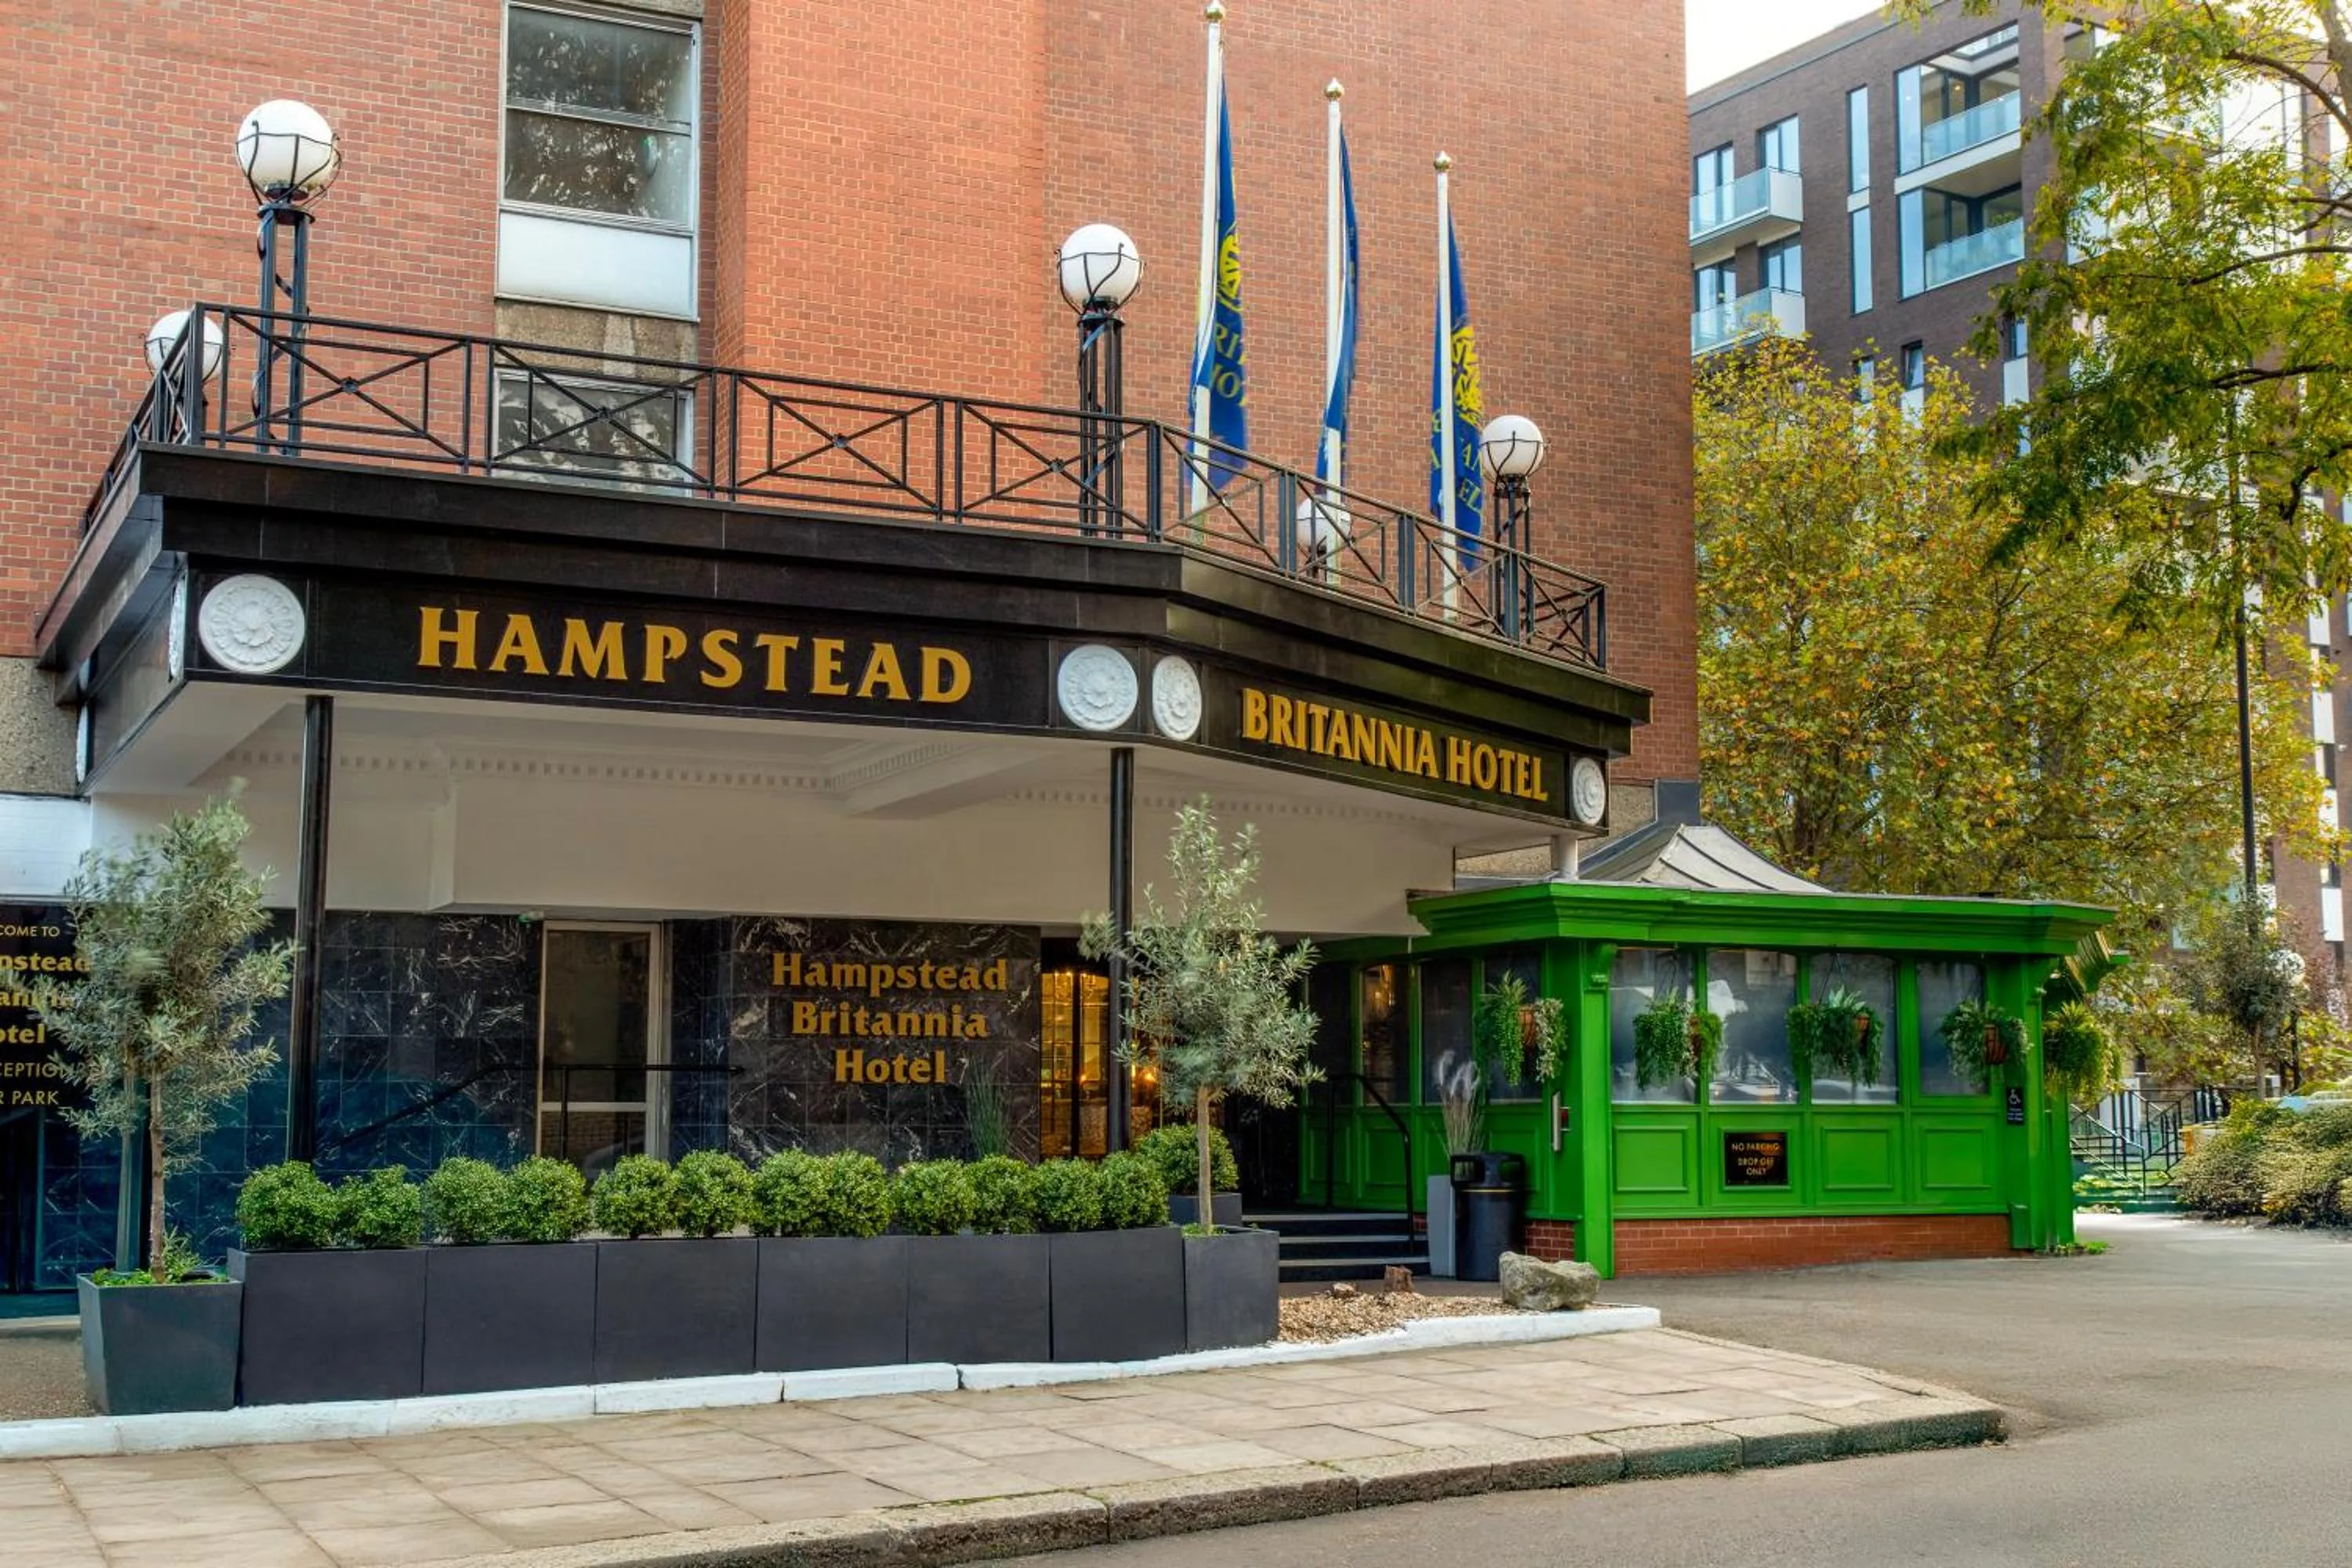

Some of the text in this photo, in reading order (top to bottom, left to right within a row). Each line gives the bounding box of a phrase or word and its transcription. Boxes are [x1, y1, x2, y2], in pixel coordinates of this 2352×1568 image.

[417, 605, 972, 703] HAMPSTEAD
[1242, 688, 1548, 802] BRITANNIA HOTEL
[41, 926, 60, 937] TO
[771, 952, 1008, 997] Hampstead
[791, 1001, 989, 1038] Britannia
[834, 1049, 946, 1083] Hotel
[12, 1091, 59, 1105] PARK
[1731, 1142, 1745, 1152] NO
